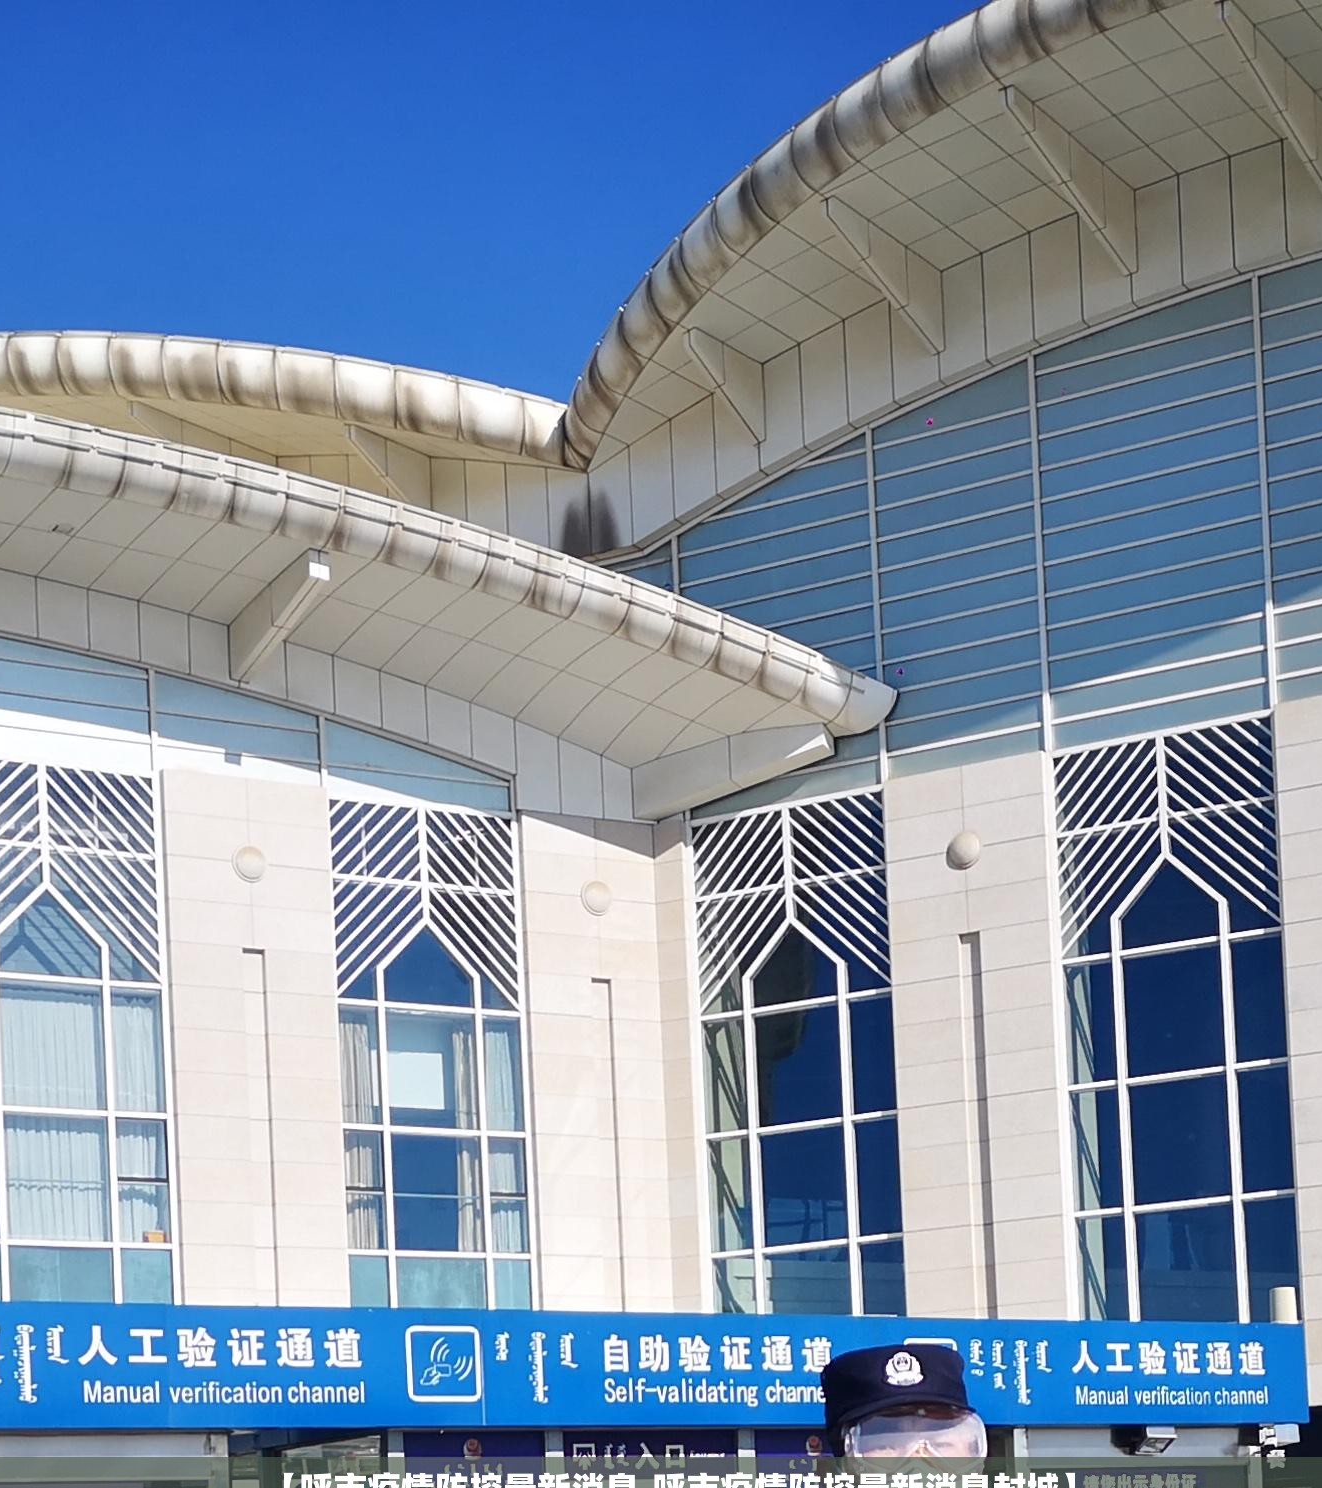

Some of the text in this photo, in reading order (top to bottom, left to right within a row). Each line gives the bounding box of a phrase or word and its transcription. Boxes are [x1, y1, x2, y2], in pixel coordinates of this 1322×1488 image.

[78, 1325, 363, 1368] 人工验证通道
[603, 1333, 832, 1373] 自助验证通道
[1072, 1340, 1267, 1376] 人工验证通道
[83, 1380, 365, 1404] Manual verification channel
[604, 1377, 827, 1407] Self-validating channe
[1076, 1385, 1269, 1406] Manual verification channel
